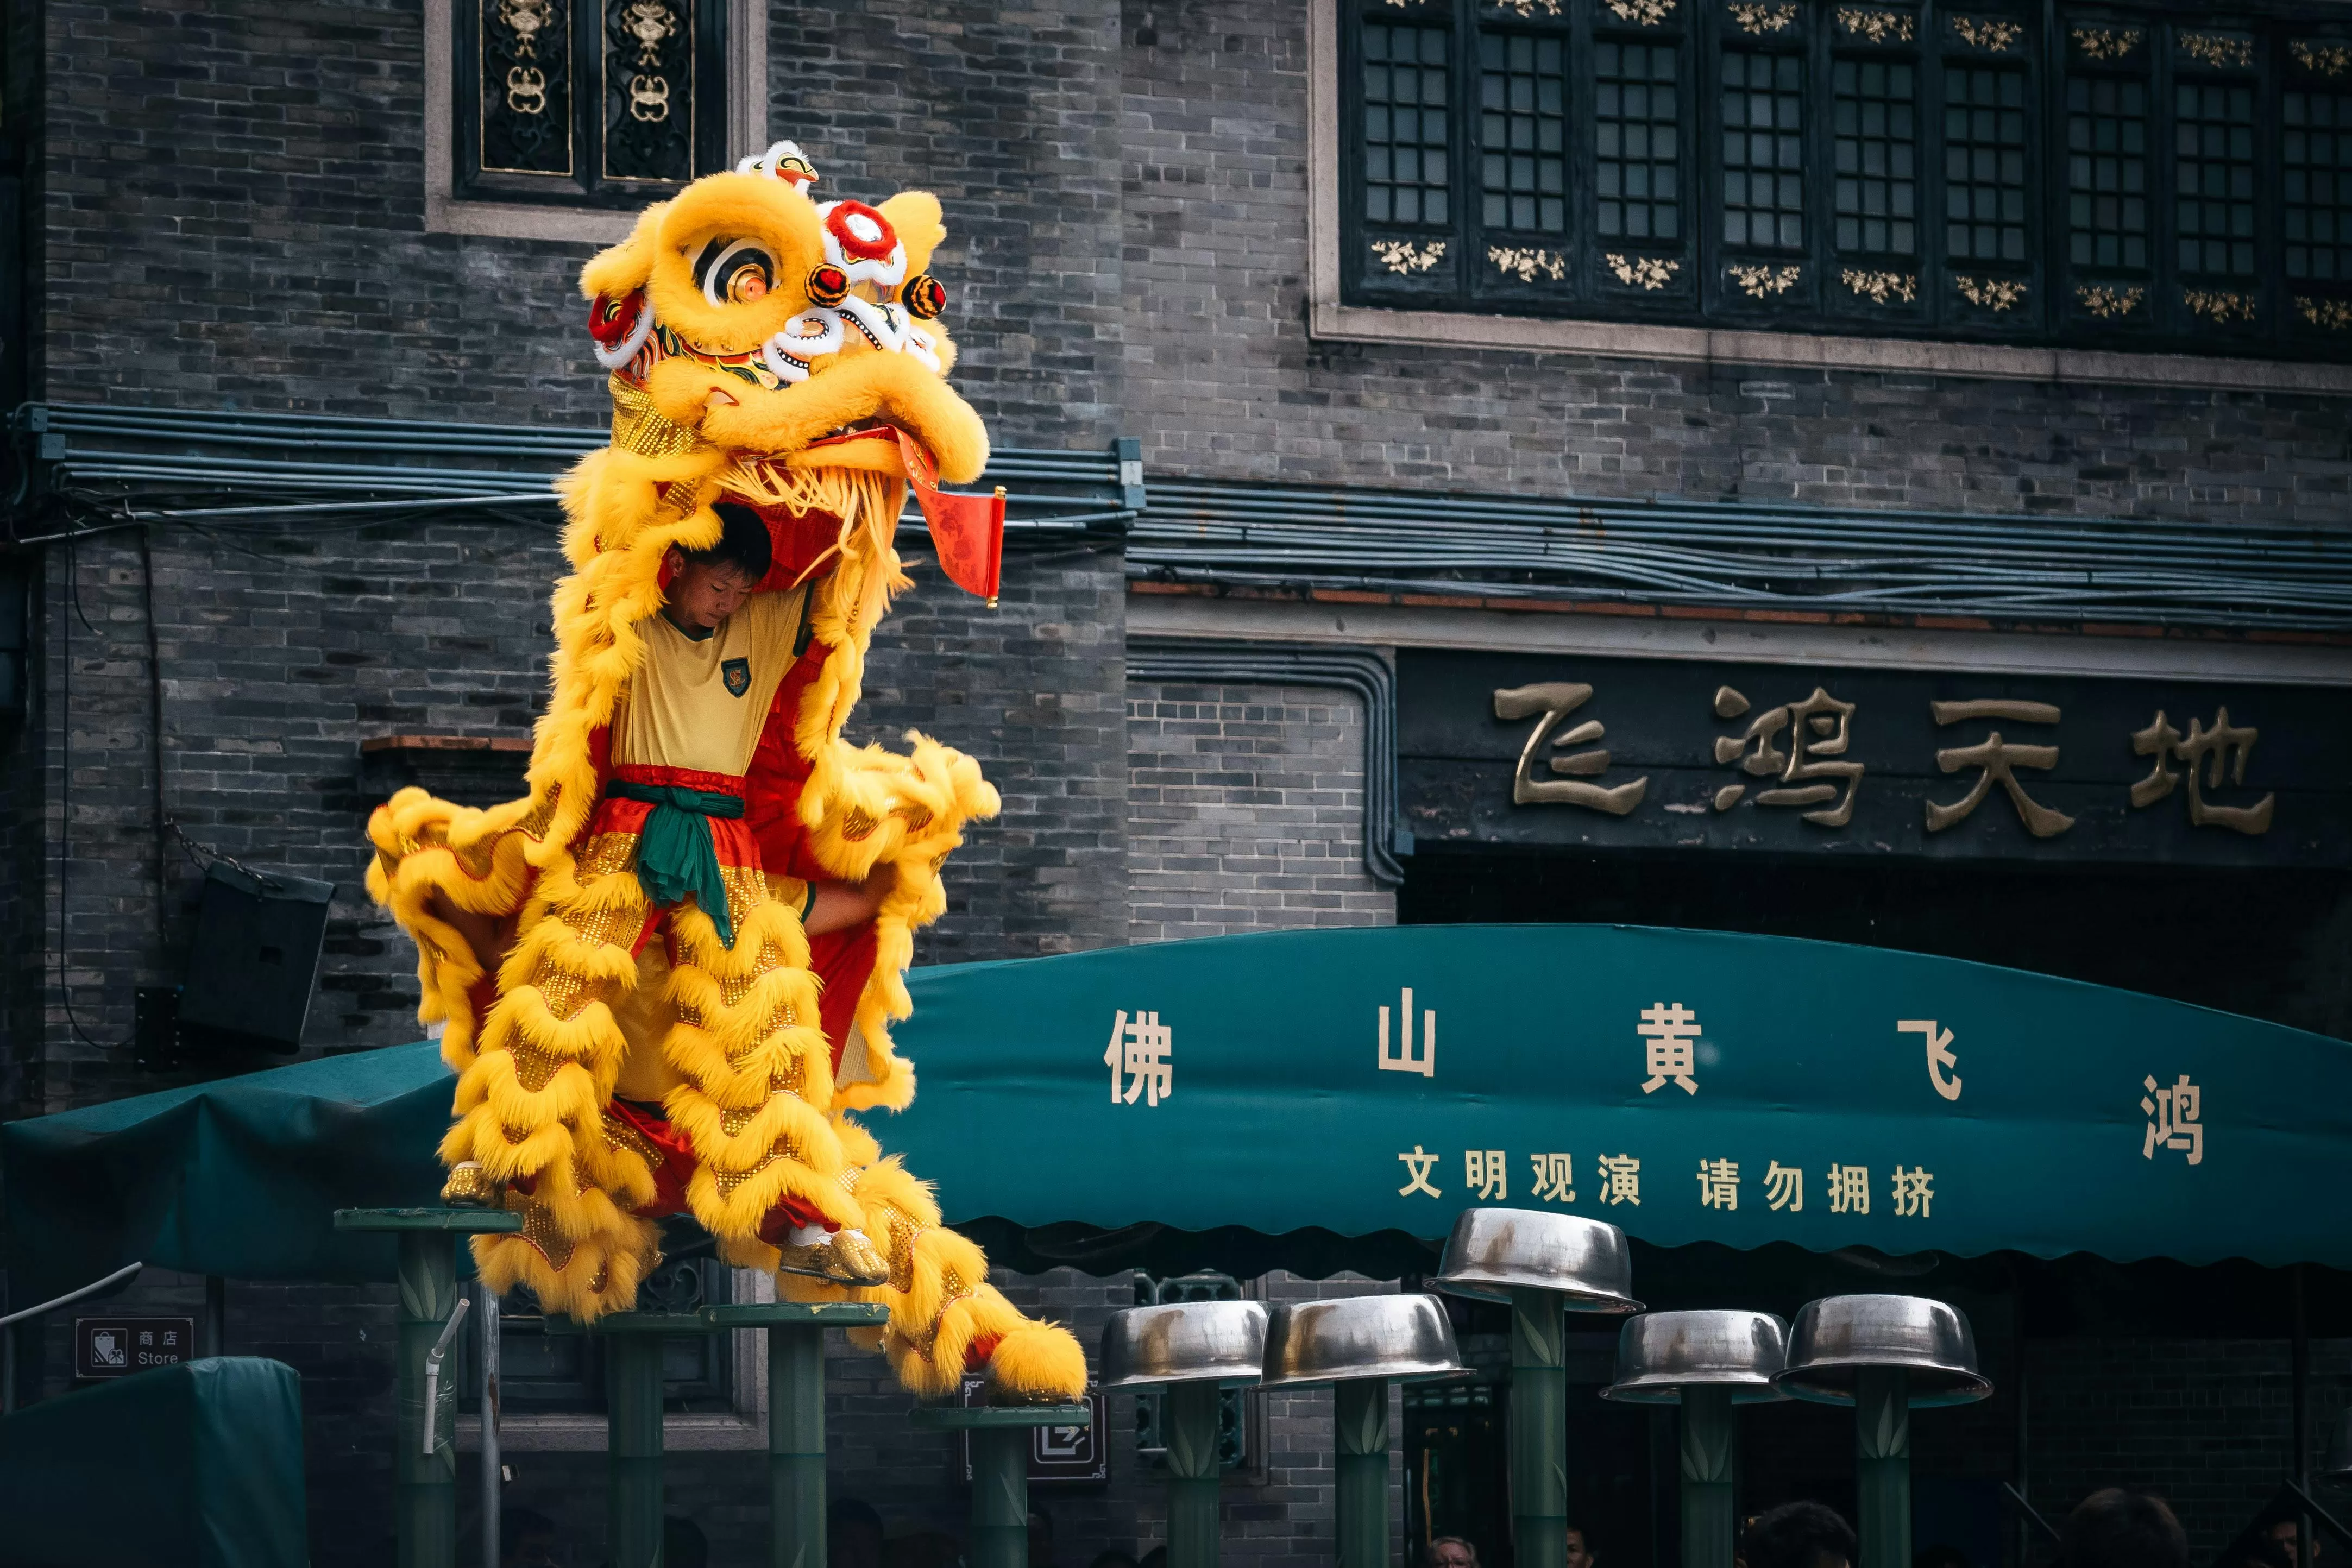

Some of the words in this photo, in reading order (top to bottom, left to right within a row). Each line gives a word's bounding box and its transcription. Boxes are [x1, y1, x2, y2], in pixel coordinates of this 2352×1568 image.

[1494, 681, 2275, 837] 飞鸿天地
[1104, 986, 2204, 1166] 佛山黄飞鸿
[1398, 1144, 1642, 1207] 文明观演
[1696, 1157, 1935, 1218] 请勿拥挤
[138, 1351, 178, 1365] Store
[139, 1331, 178, 1346] 商店
